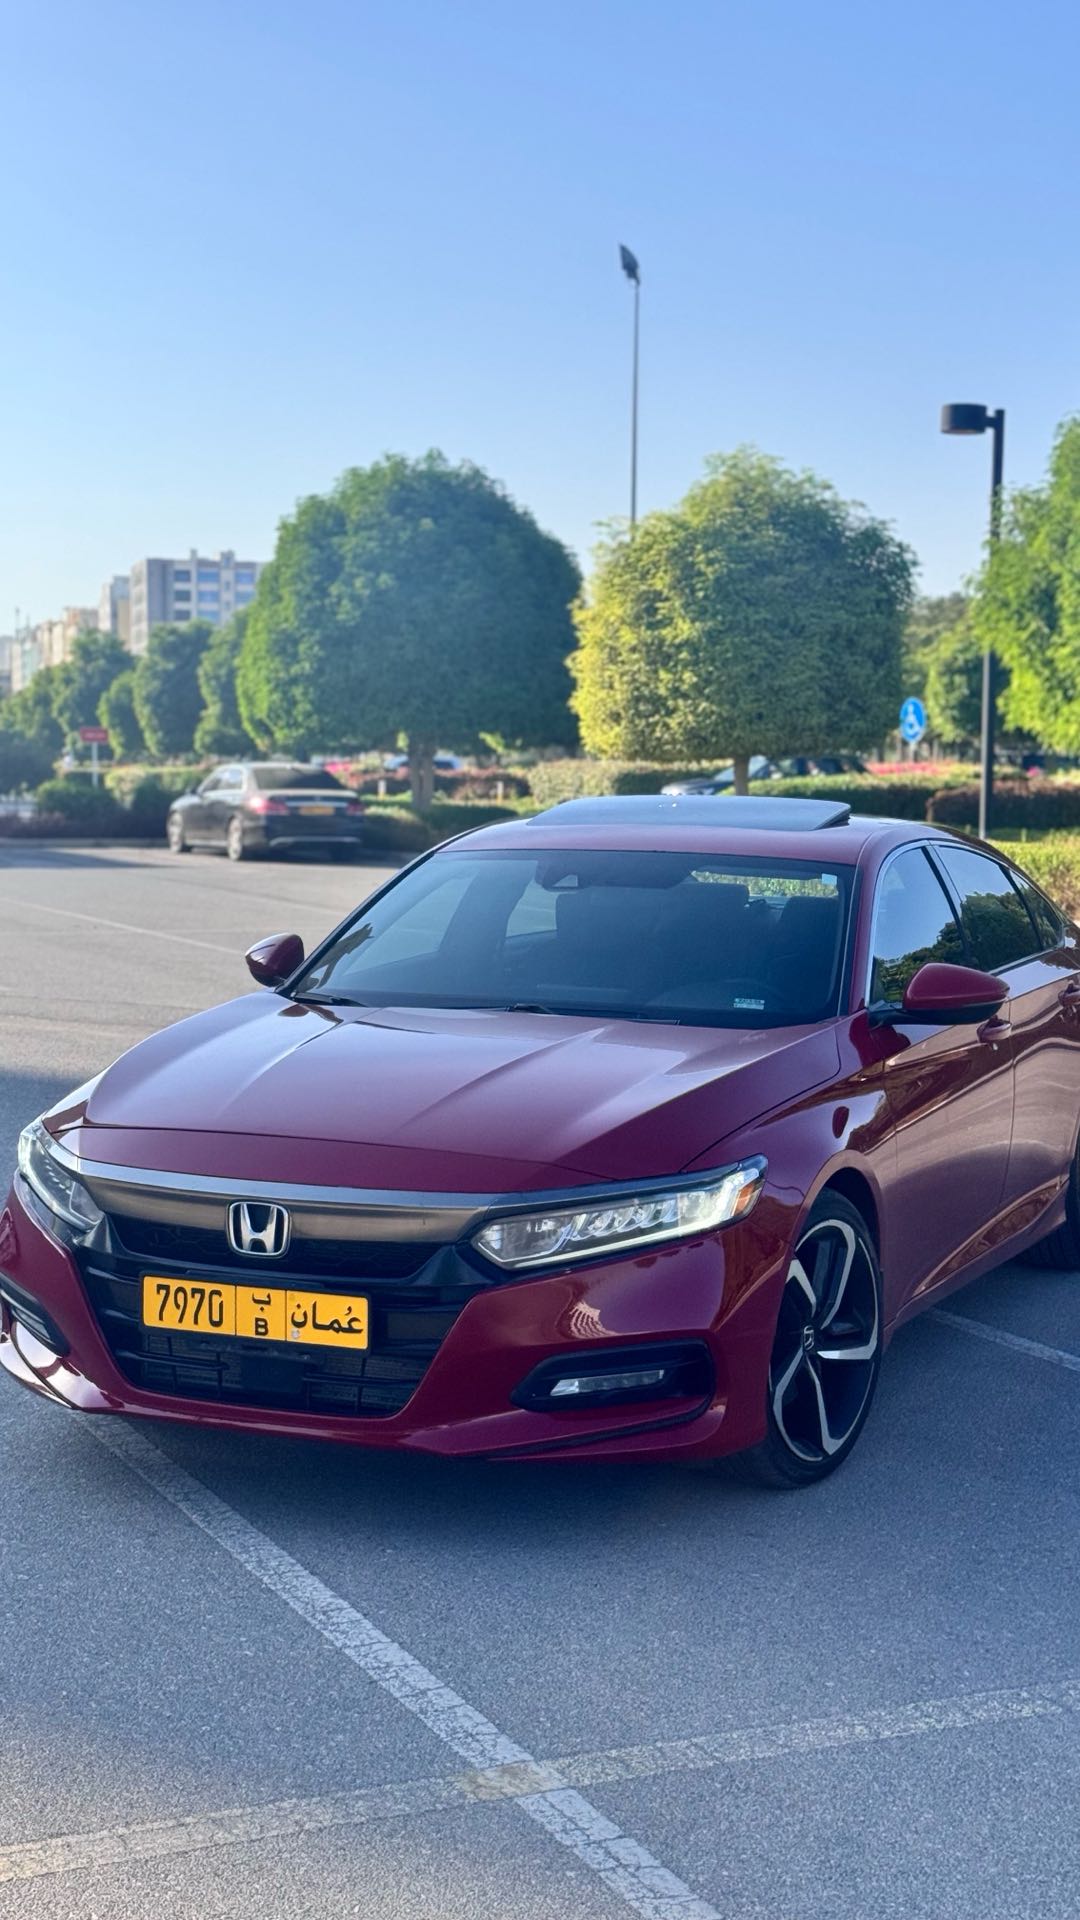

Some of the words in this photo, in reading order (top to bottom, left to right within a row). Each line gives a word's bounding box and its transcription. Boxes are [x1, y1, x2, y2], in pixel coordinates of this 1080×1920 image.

[156, 1284, 223, 1327] 7970
[252, 1292, 271, 1312] ب
[254, 1318, 269, 1336] B
